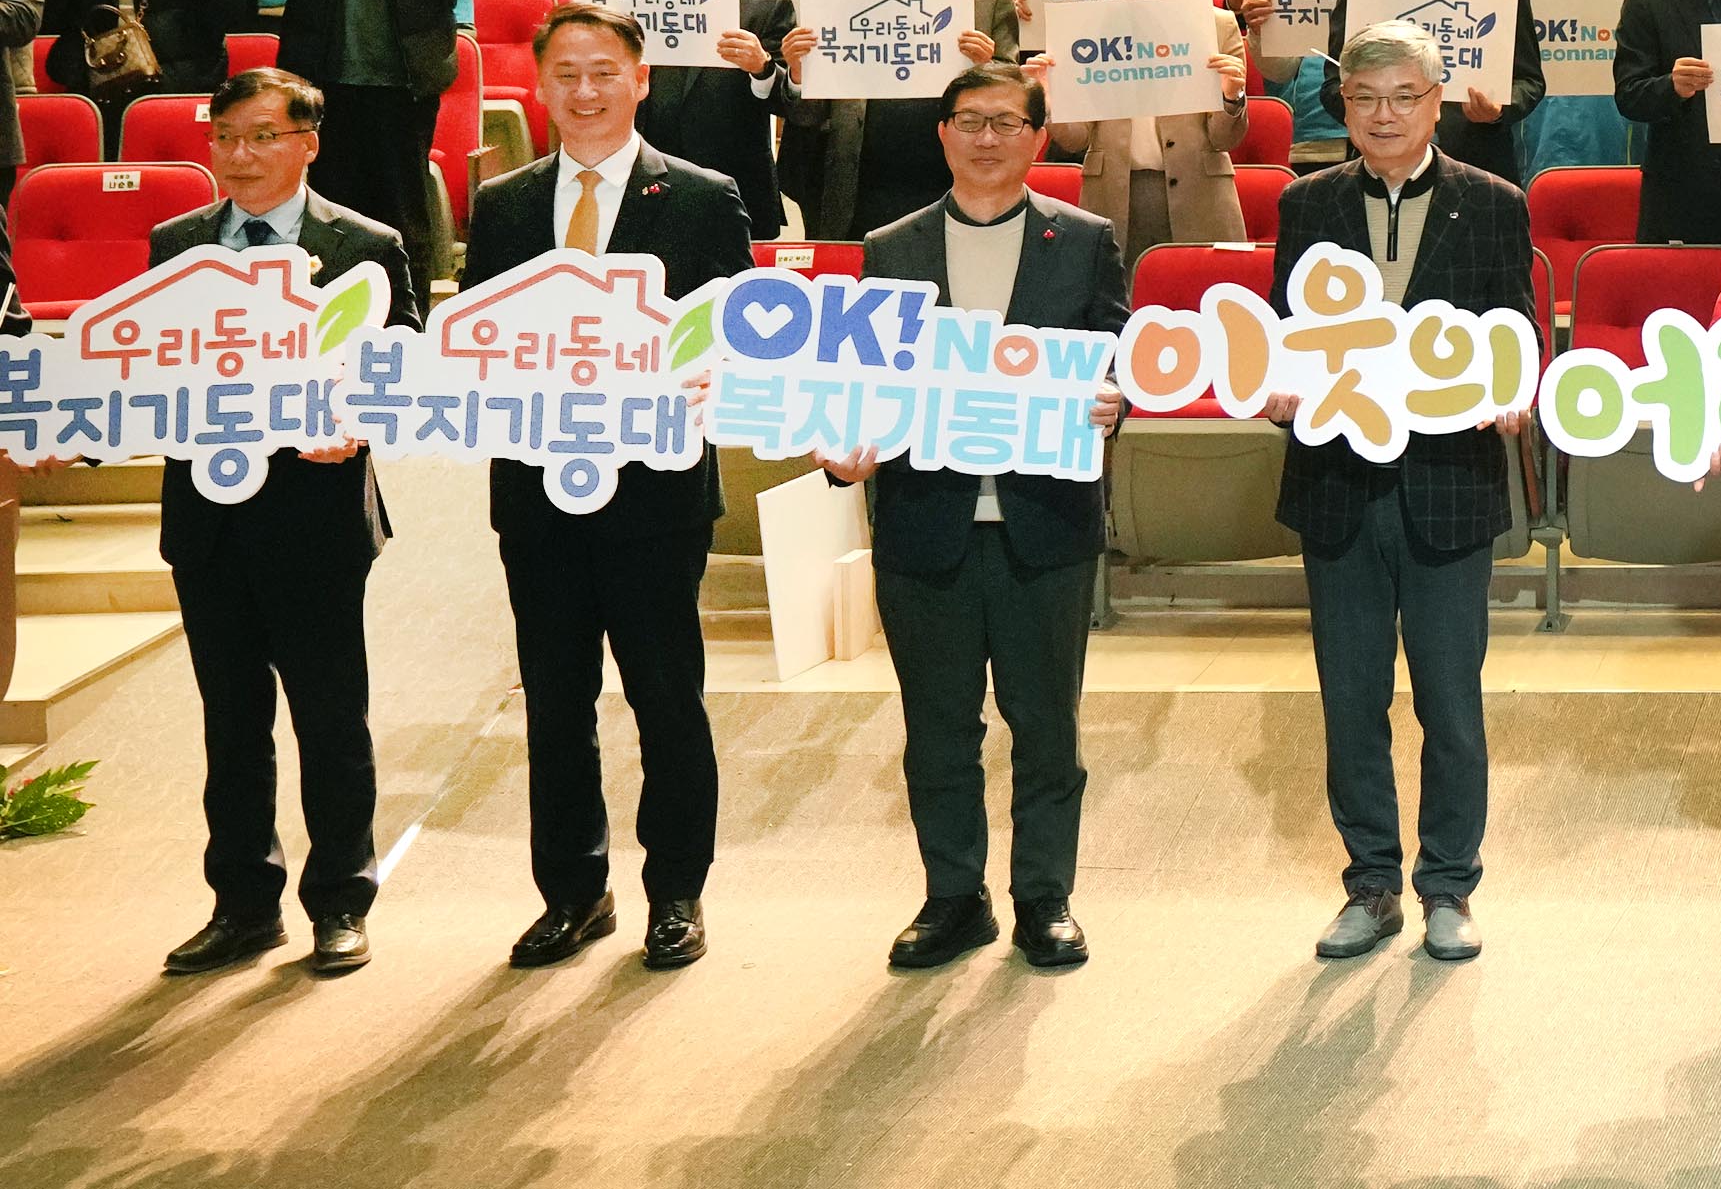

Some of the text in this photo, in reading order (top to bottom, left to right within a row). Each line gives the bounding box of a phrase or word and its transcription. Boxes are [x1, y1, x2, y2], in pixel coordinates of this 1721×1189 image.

[819, 25, 942, 81] 복지기동대
[851, 10, 932, 39] 우리동네
[1072, 36, 1189, 64] OK! Now
[1076, 59, 1192, 85] Jeonnam
[94, 308, 307, 378] 우리동네
[449, 313, 660, 382] 우리동네
[722, 269, 1105, 383] OK! Now
[1130, 257, 1520, 447] 이웃의
[0, 349, 336, 492] 복지기동대
[346, 341, 689, 497] 복지기동대
[713, 371, 1096, 473] 복지기동대
